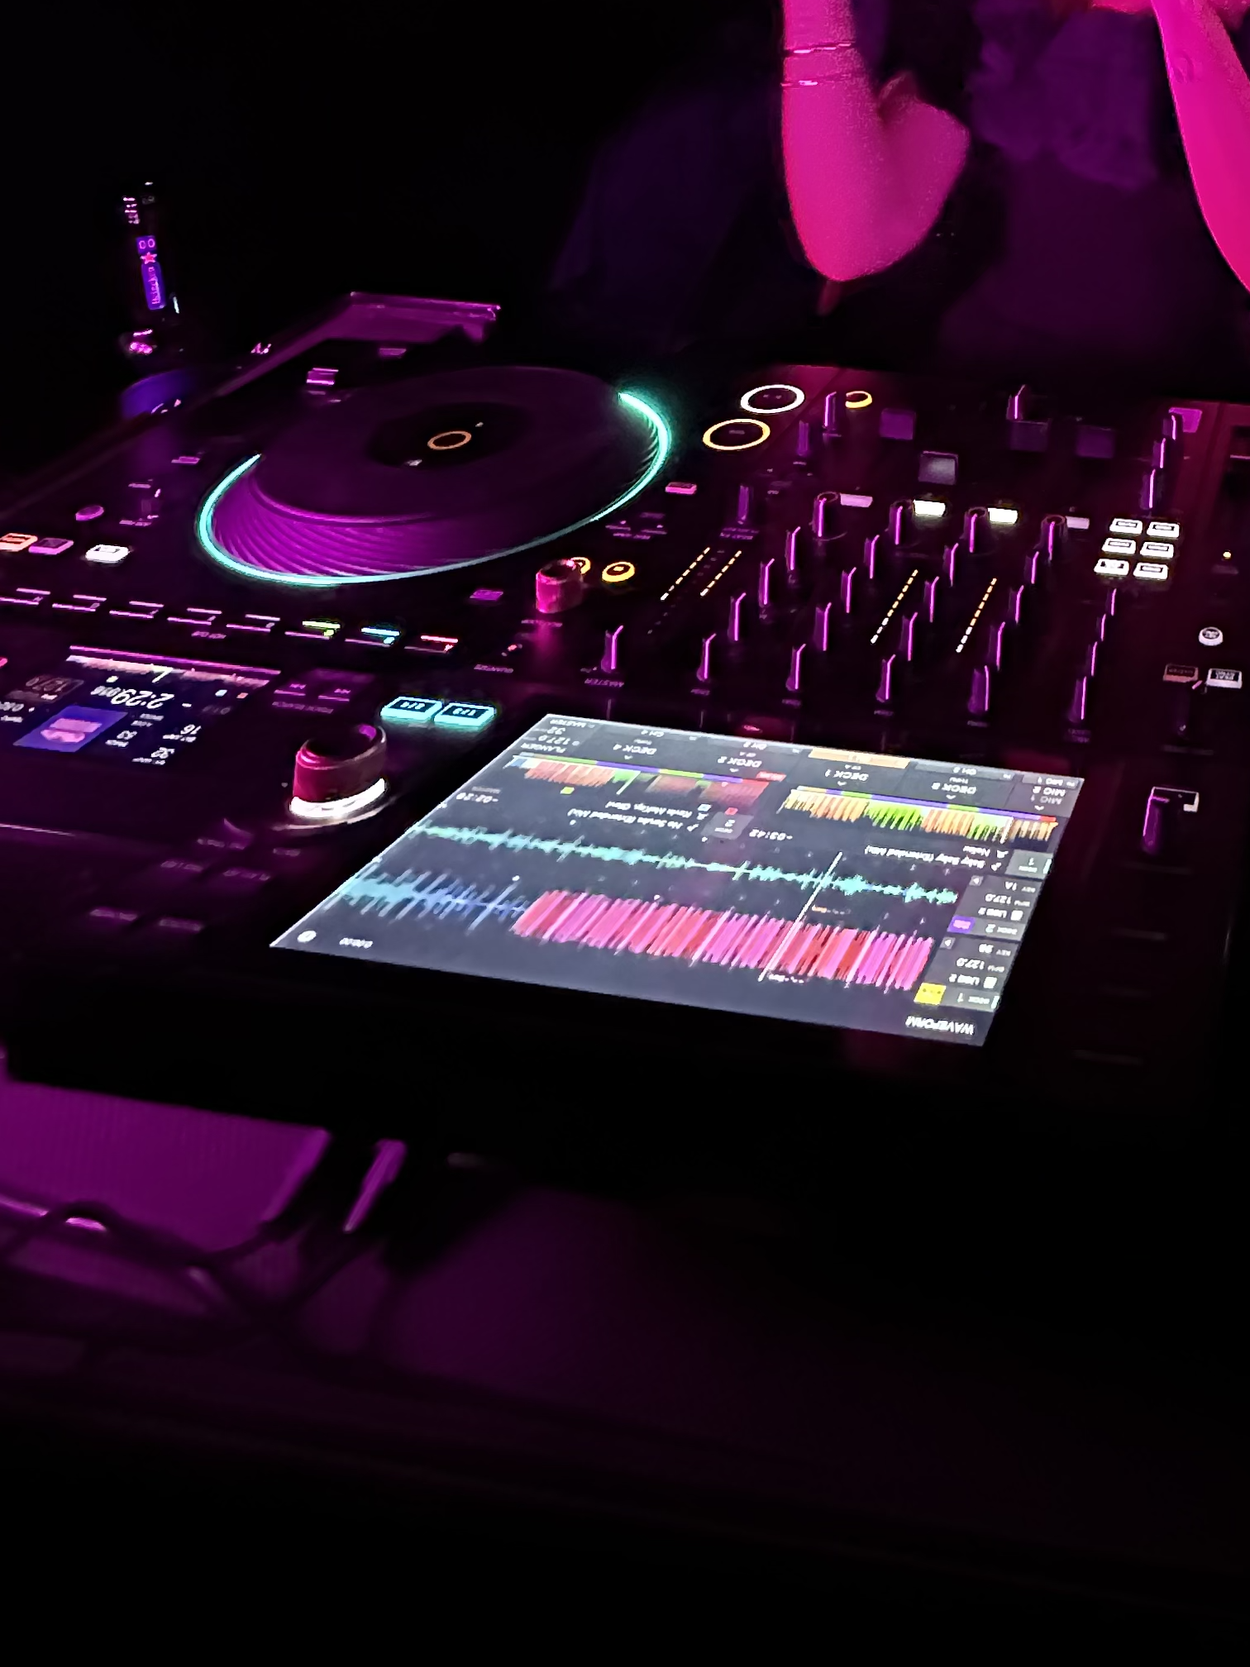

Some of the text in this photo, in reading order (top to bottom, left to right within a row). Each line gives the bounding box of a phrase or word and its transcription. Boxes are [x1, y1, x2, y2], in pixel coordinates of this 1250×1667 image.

[623, 745, 657, 755] DECK
[727, 757, 762, 768] DECK
[833, 770, 869, 781] DECK
[942, 783, 977, 794] DECK
[905, 1015, 974, 1036] WAVEFORM
